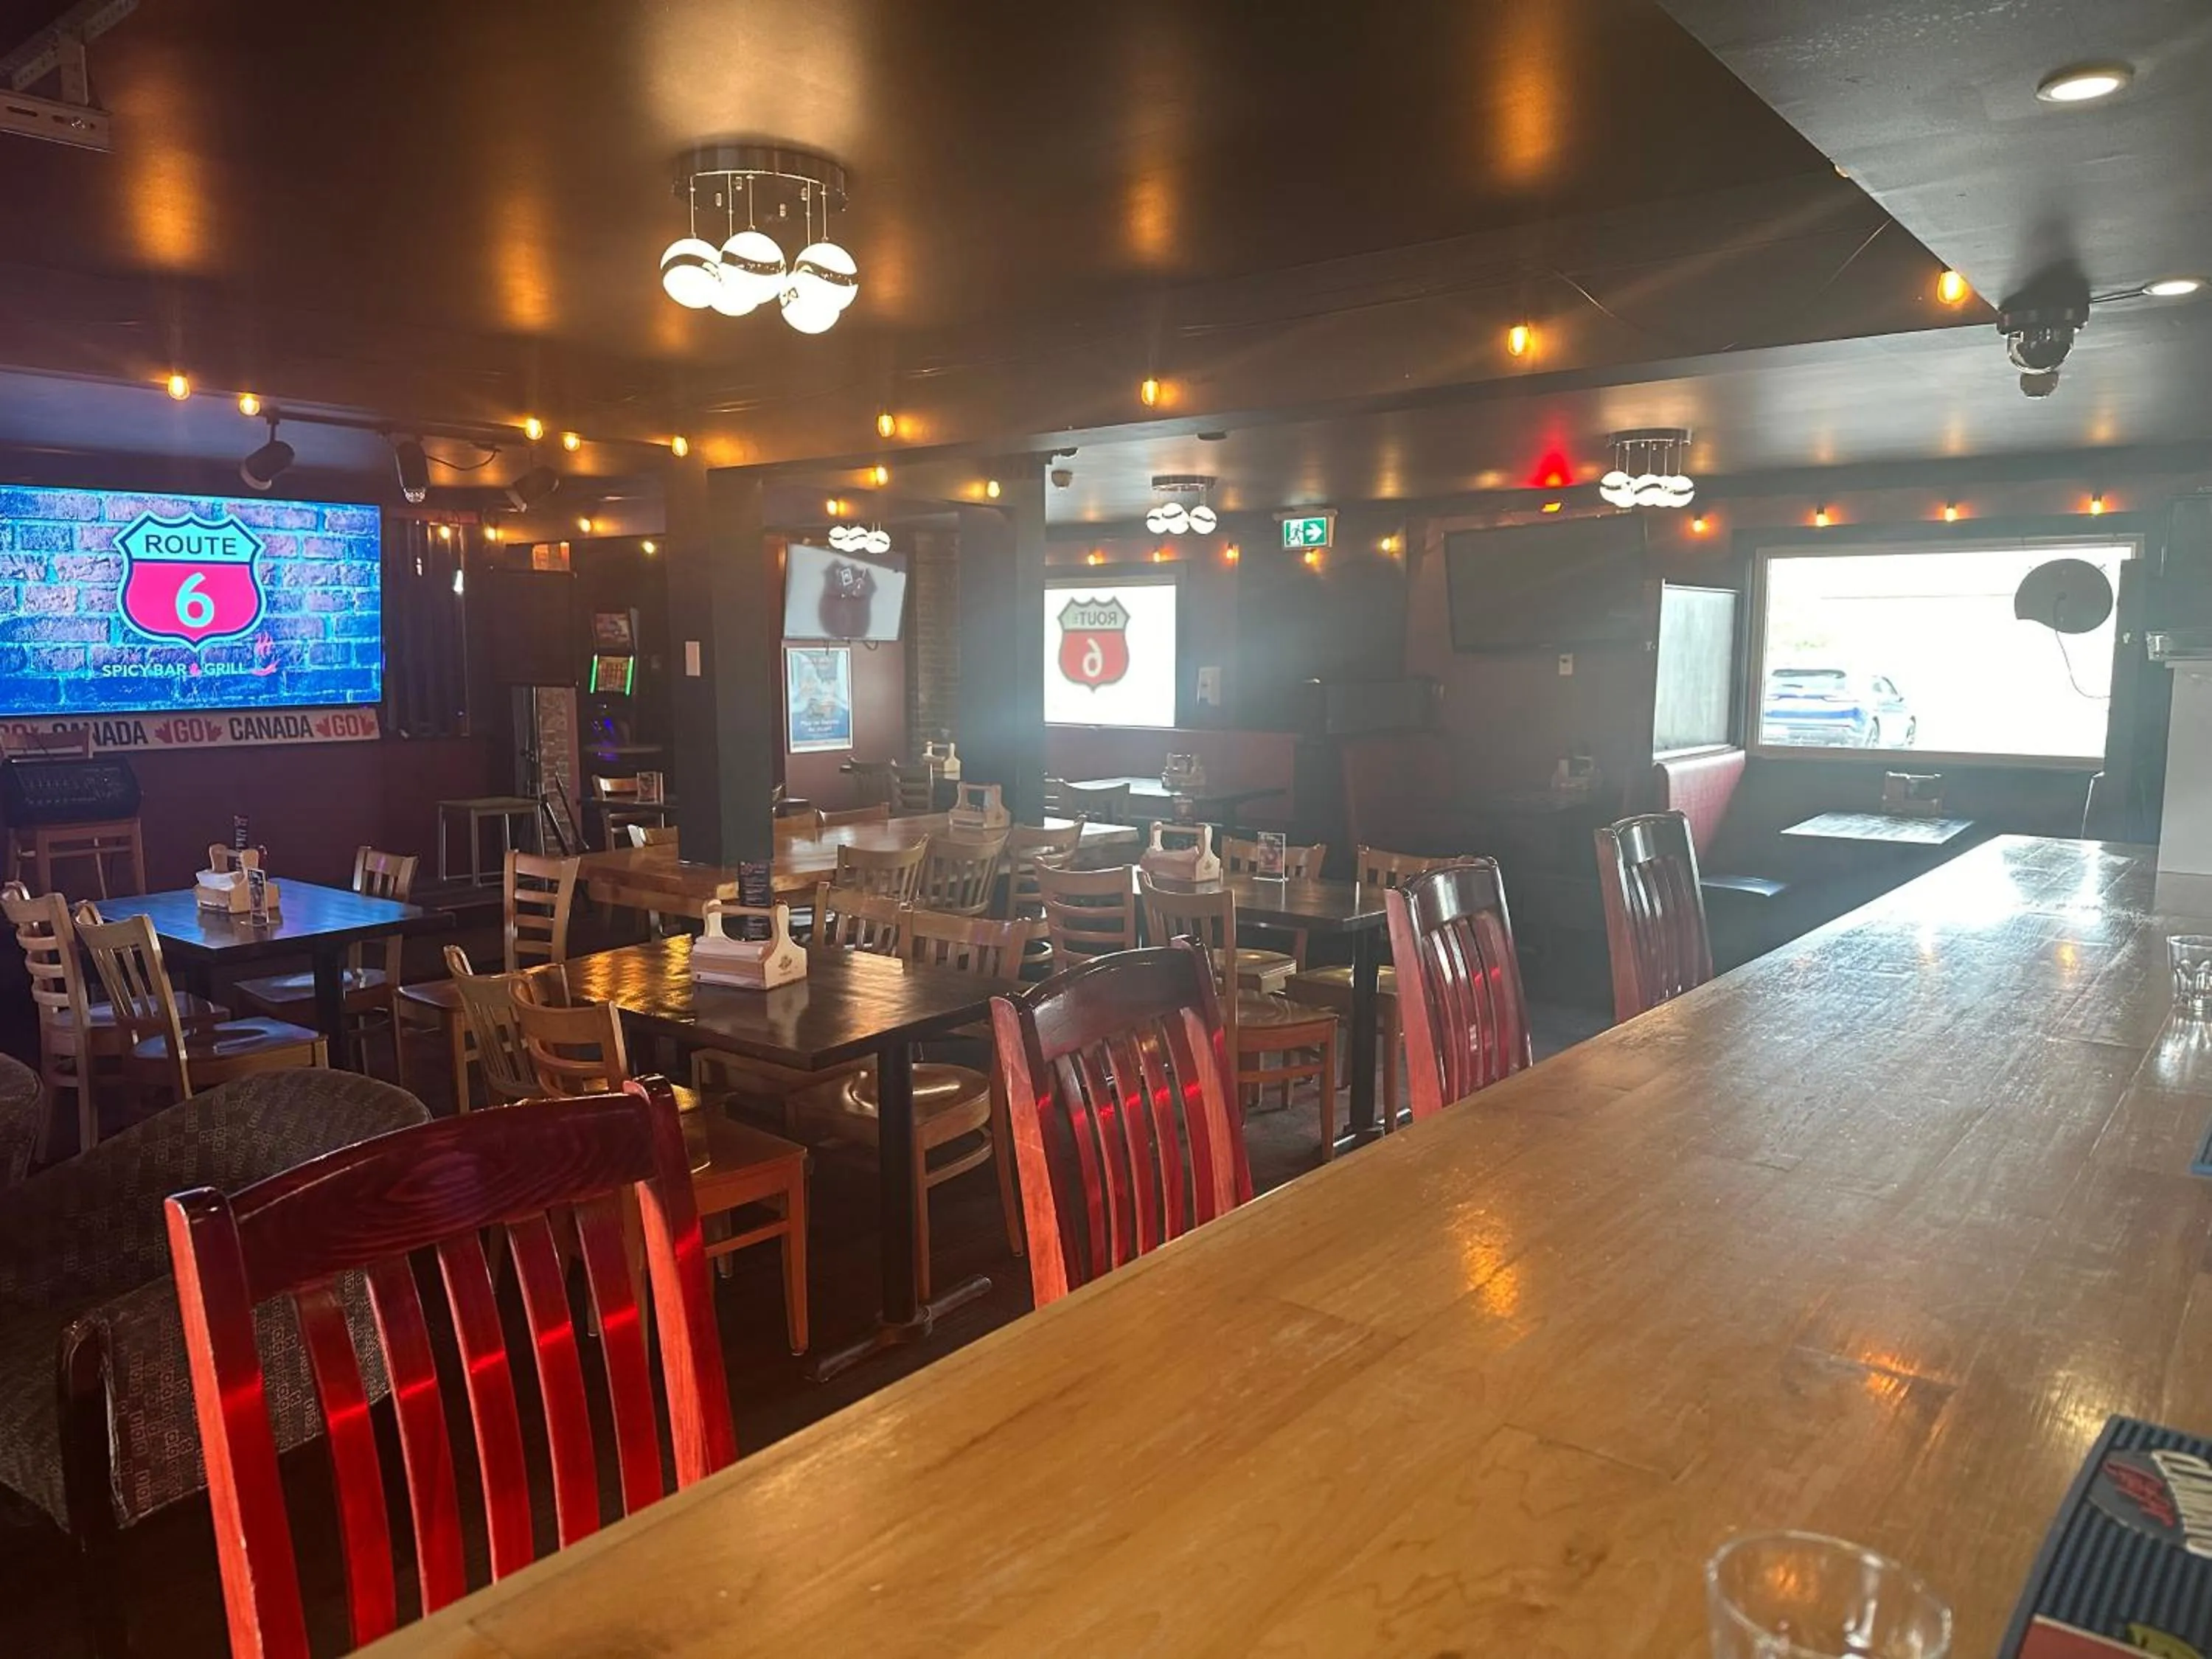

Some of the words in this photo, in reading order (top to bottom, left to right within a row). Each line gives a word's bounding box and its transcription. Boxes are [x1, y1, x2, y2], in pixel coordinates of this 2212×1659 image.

[145, 534, 237, 555] ROUTE
[175, 571, 215, 628] 6
[102, 664, 150, 678] SPICY
[153, 663, 186, 675] BAR
[204, 662, 247, 675] GRILL
[173, 718, 203, 743] GO
[229, 715, 314, 741] CANADA
[333, 714, 359, 736] GO
